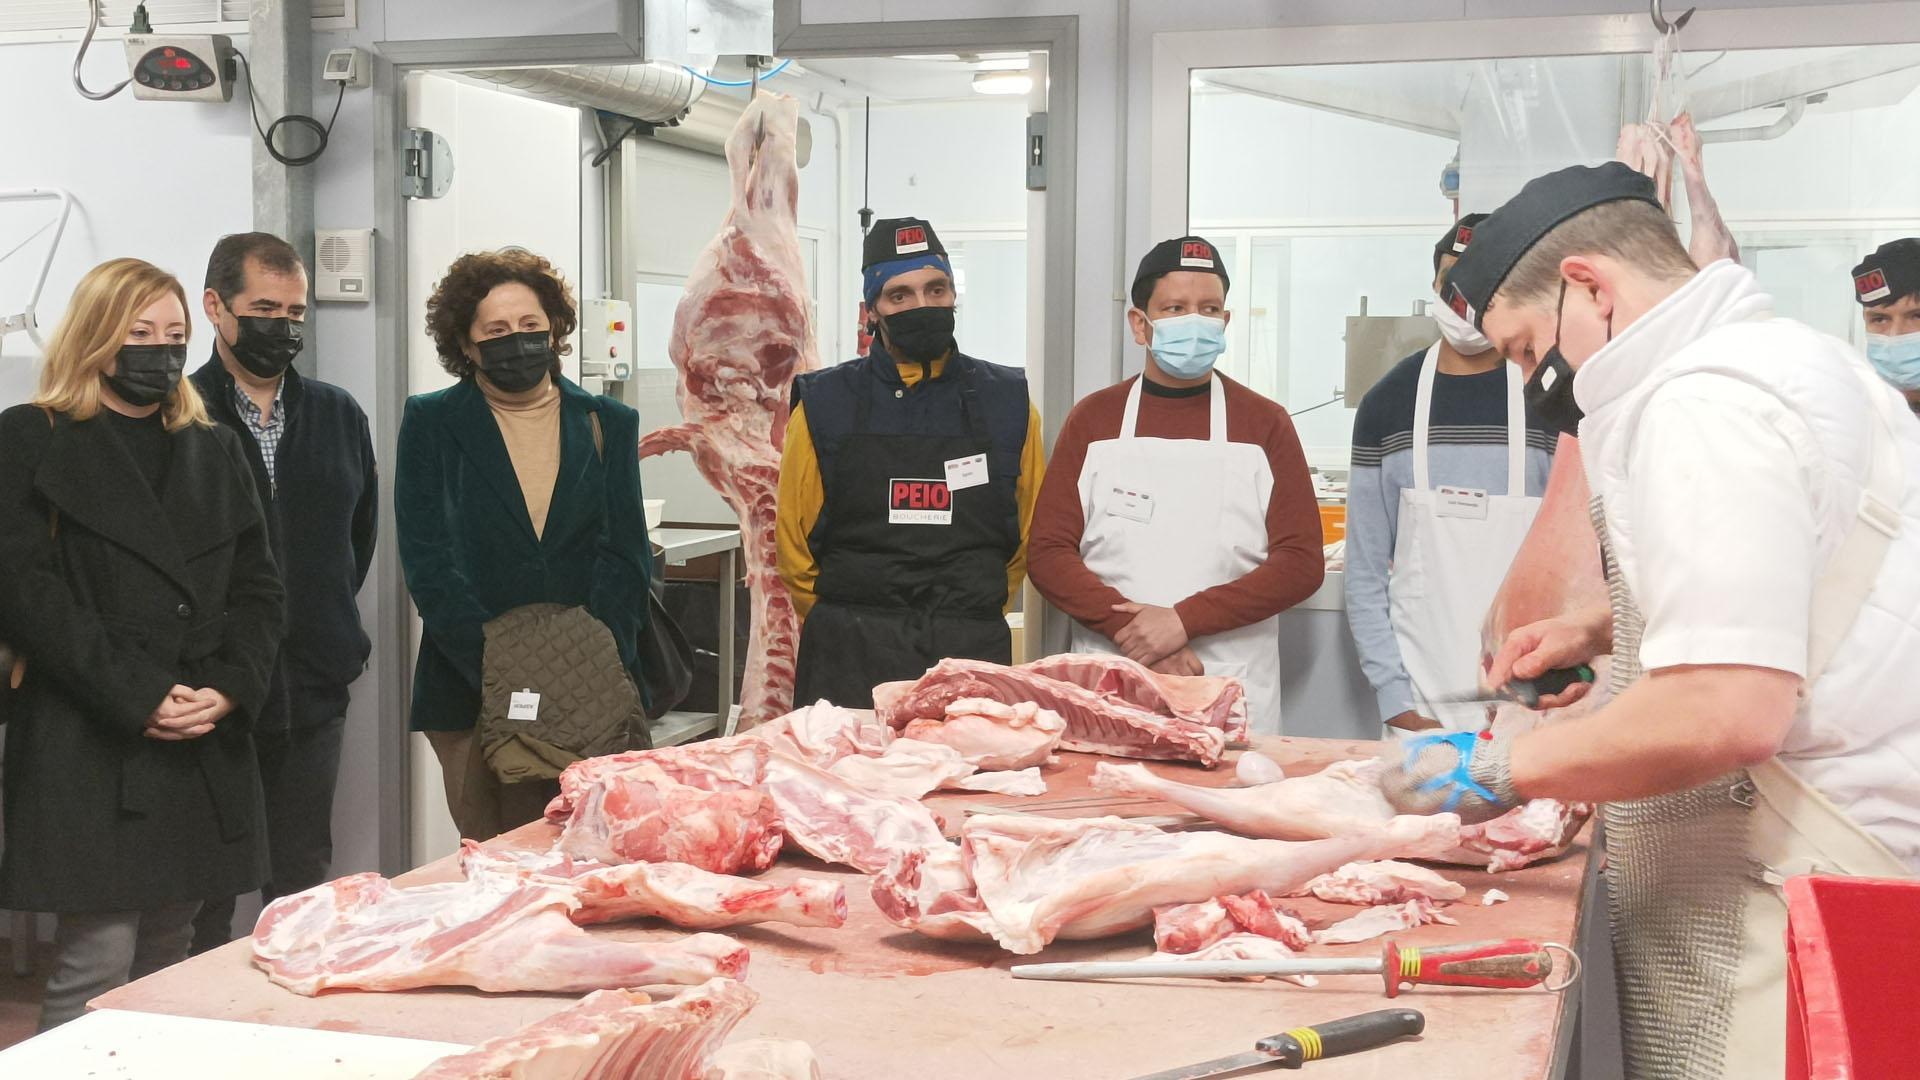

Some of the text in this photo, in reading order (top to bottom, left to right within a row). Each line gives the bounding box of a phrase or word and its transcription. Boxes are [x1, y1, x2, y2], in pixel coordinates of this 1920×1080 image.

[898, 228, 924, 244] PEIO
[1458, 228, 1473, 245] PE
[1184, 243, 1211, 259] PEIO
[1856, 272, 1883, 293] EIO
[893, 482, 949, 508] PEIO
[892, 512, 949, 522] BOUCHERIE
